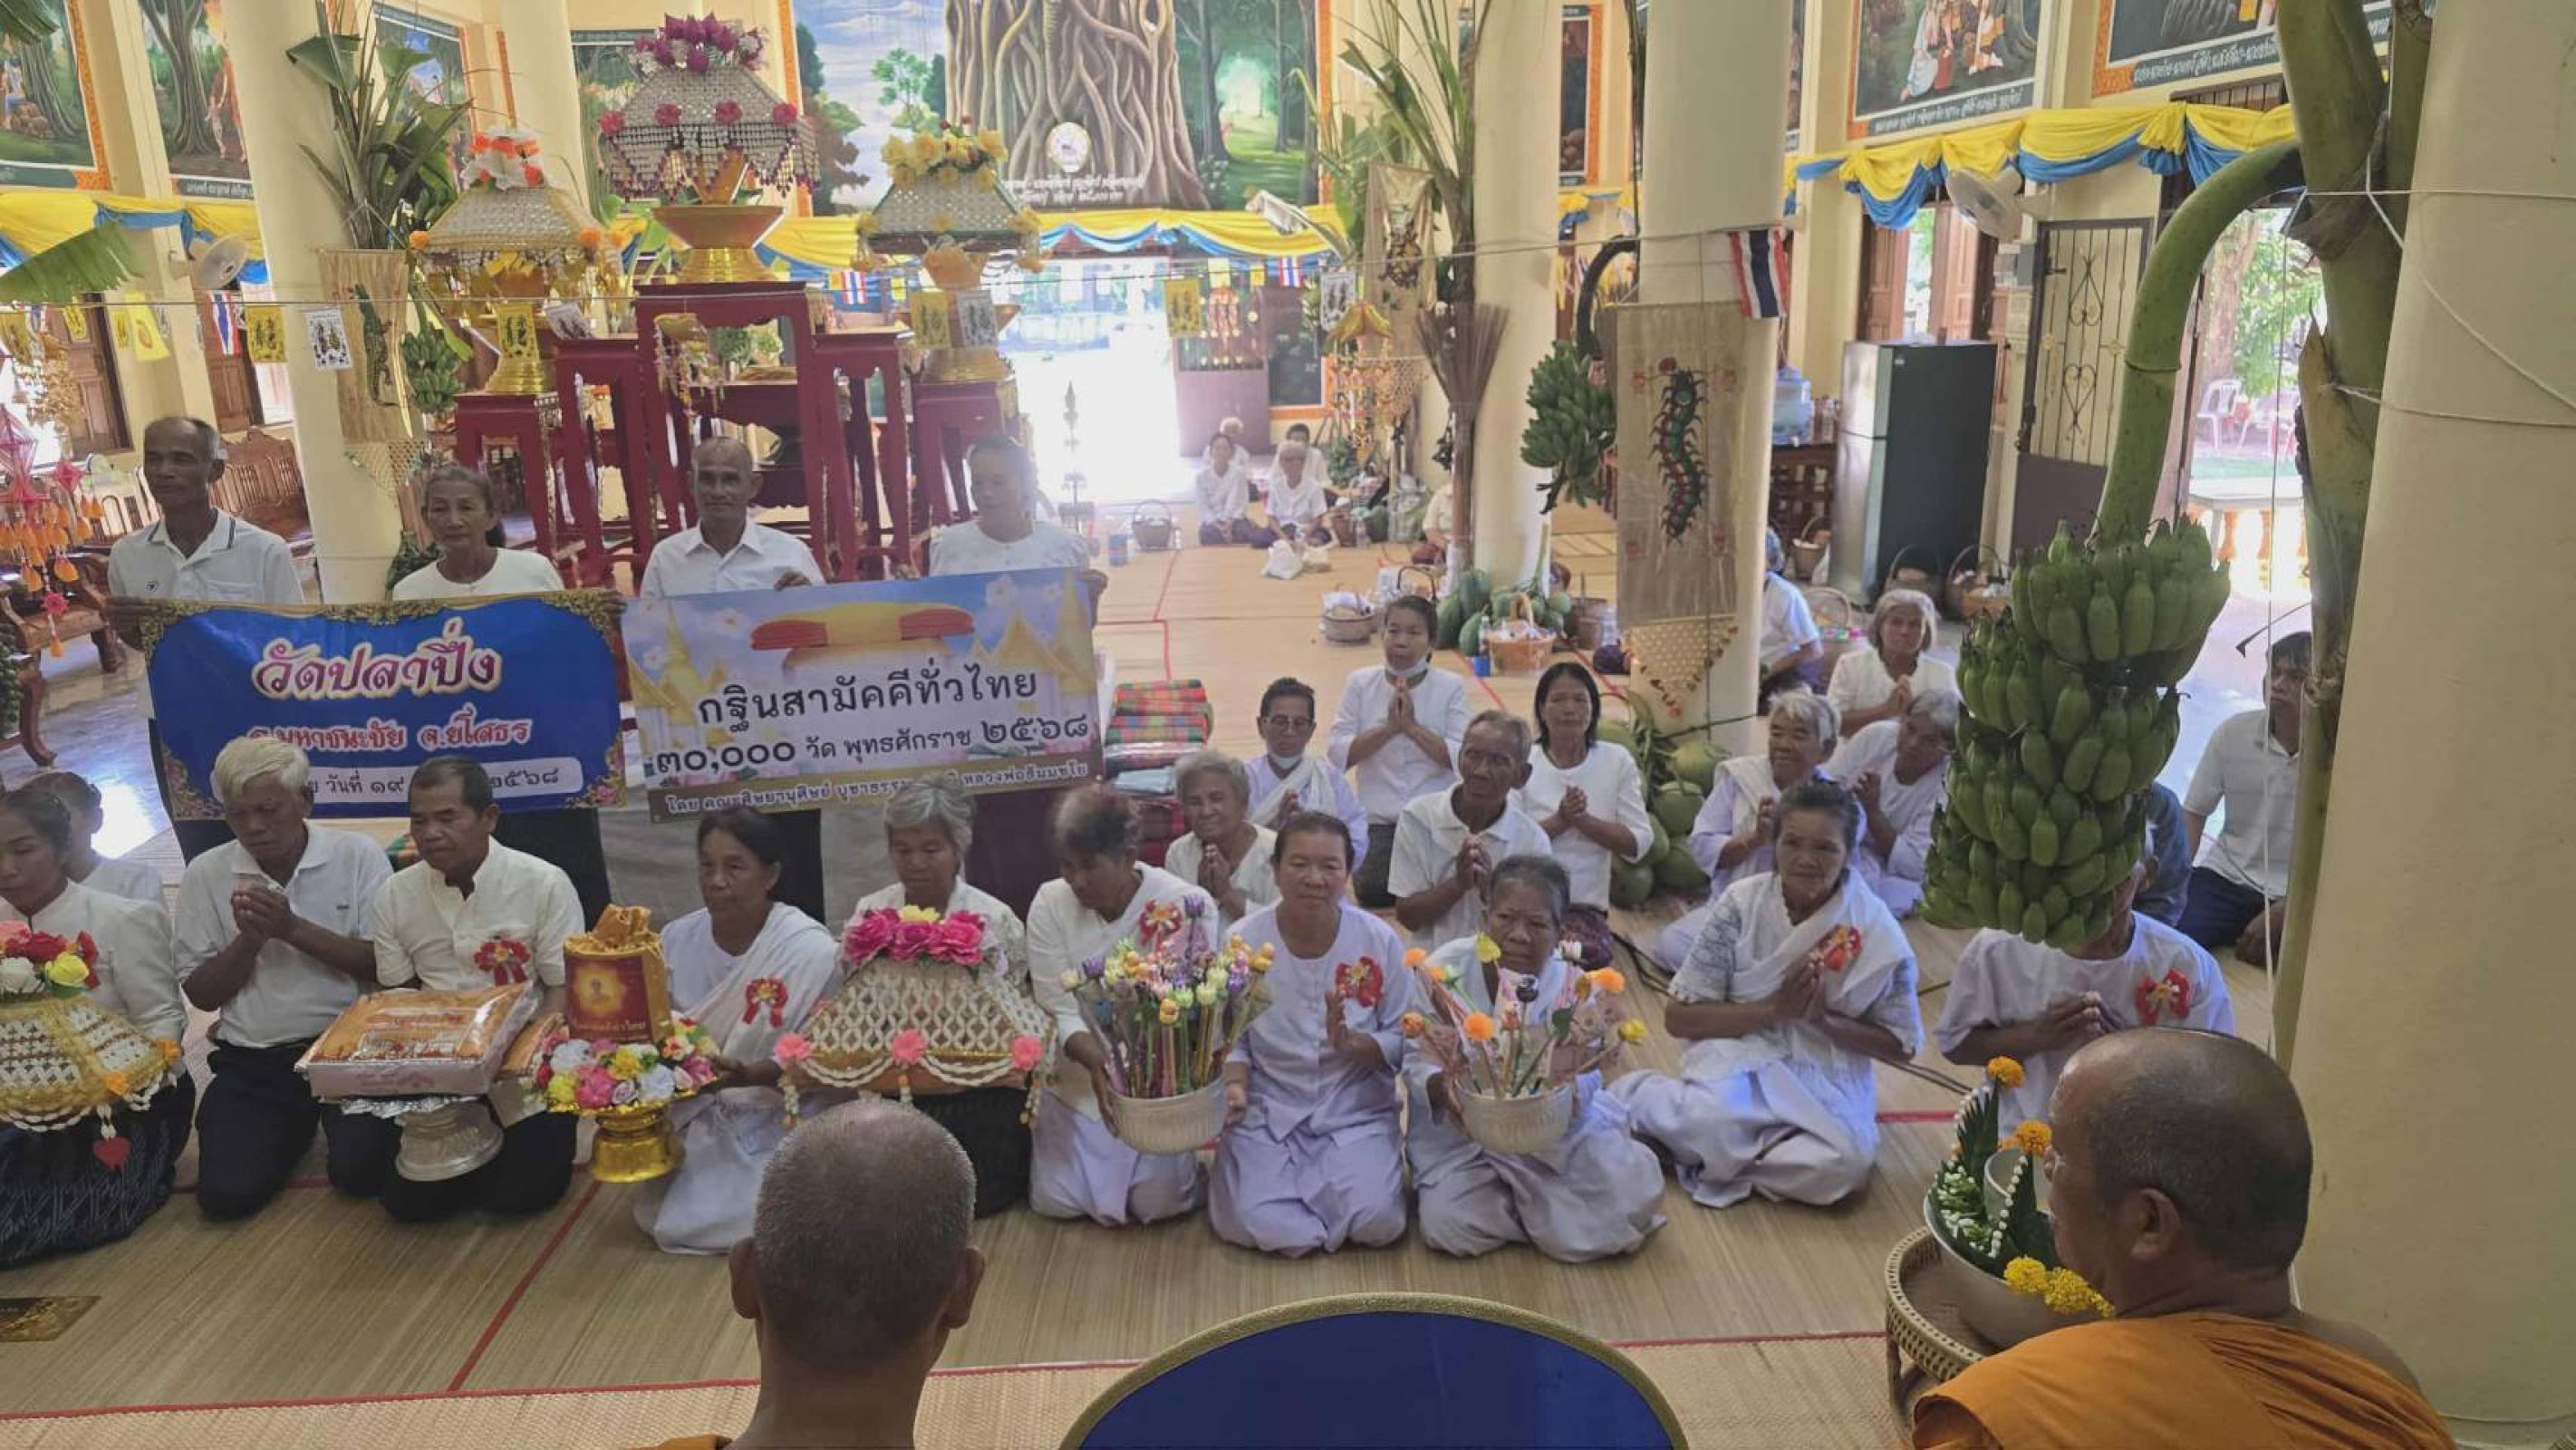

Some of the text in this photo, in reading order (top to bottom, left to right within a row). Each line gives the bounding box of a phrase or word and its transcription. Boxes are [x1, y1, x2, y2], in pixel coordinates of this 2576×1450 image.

[698, 657, 1037, 732] กฐินสามัคคีทั่วไทย
[418, 702, 533, 751] จ.ยโสธร
[806, 737, 837, 759] วัด
[843, 729, 972, 764] พุทธศักราช
[981, 715, 1089, 745] ๒๕๖๘
[324, 768, 363, 794] วันที่
[370, 774, 405, 793] ๑๙
